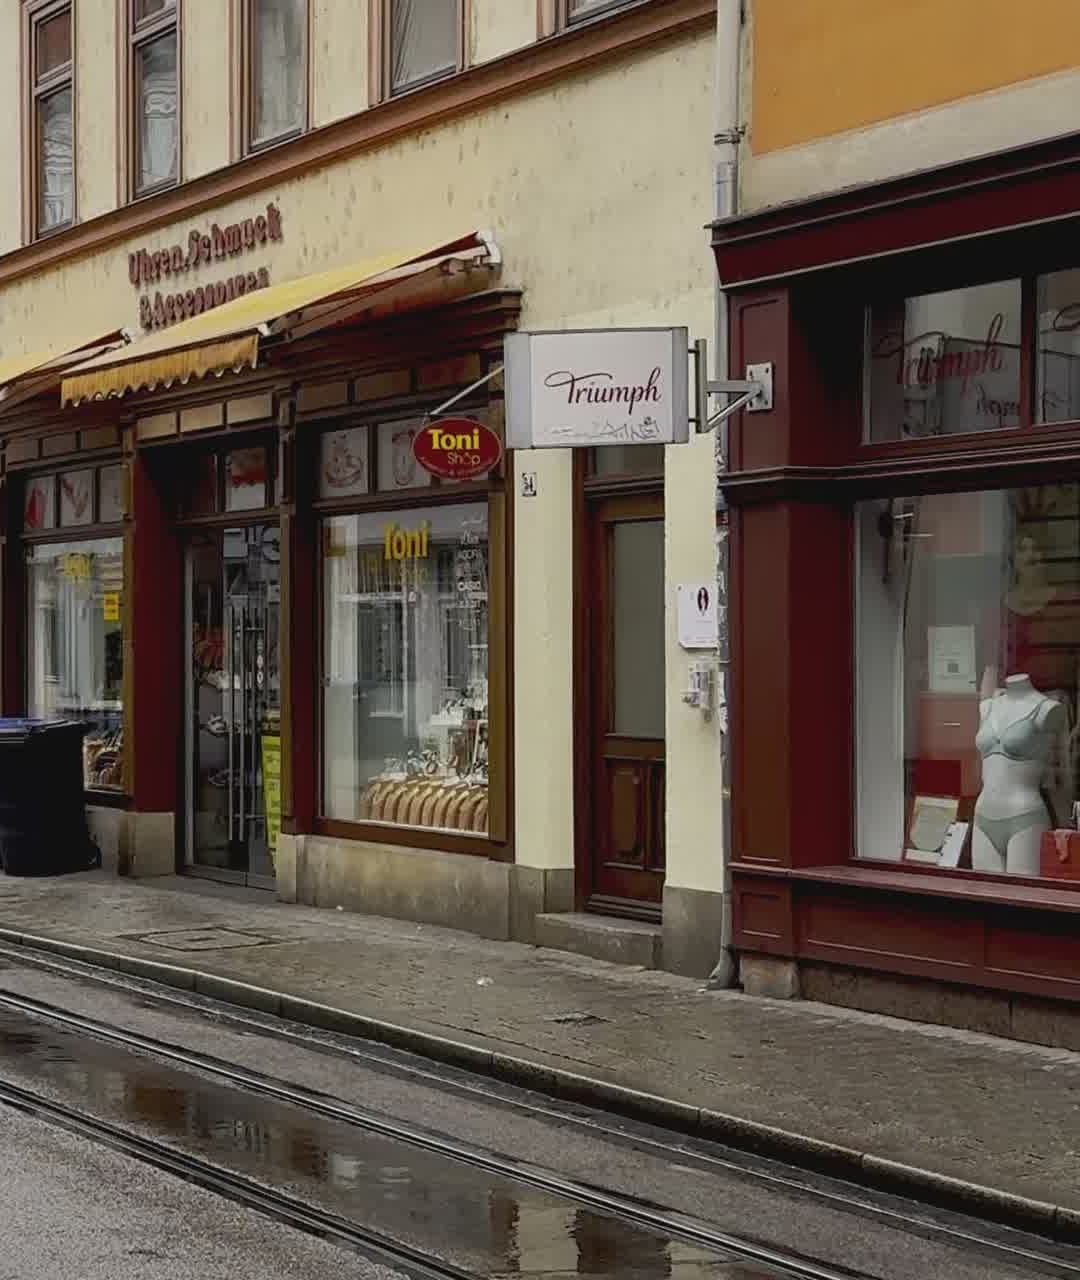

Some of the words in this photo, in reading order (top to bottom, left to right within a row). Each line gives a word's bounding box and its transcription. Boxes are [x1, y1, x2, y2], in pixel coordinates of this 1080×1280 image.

[186, 200, 283, 267] Schmuck
[544, 367, 663, 416] Triumph
[427, 428, 481, 451] Toni
[447, 452, 482, 469] Shop
[383, 522, 431, 561] Toni
